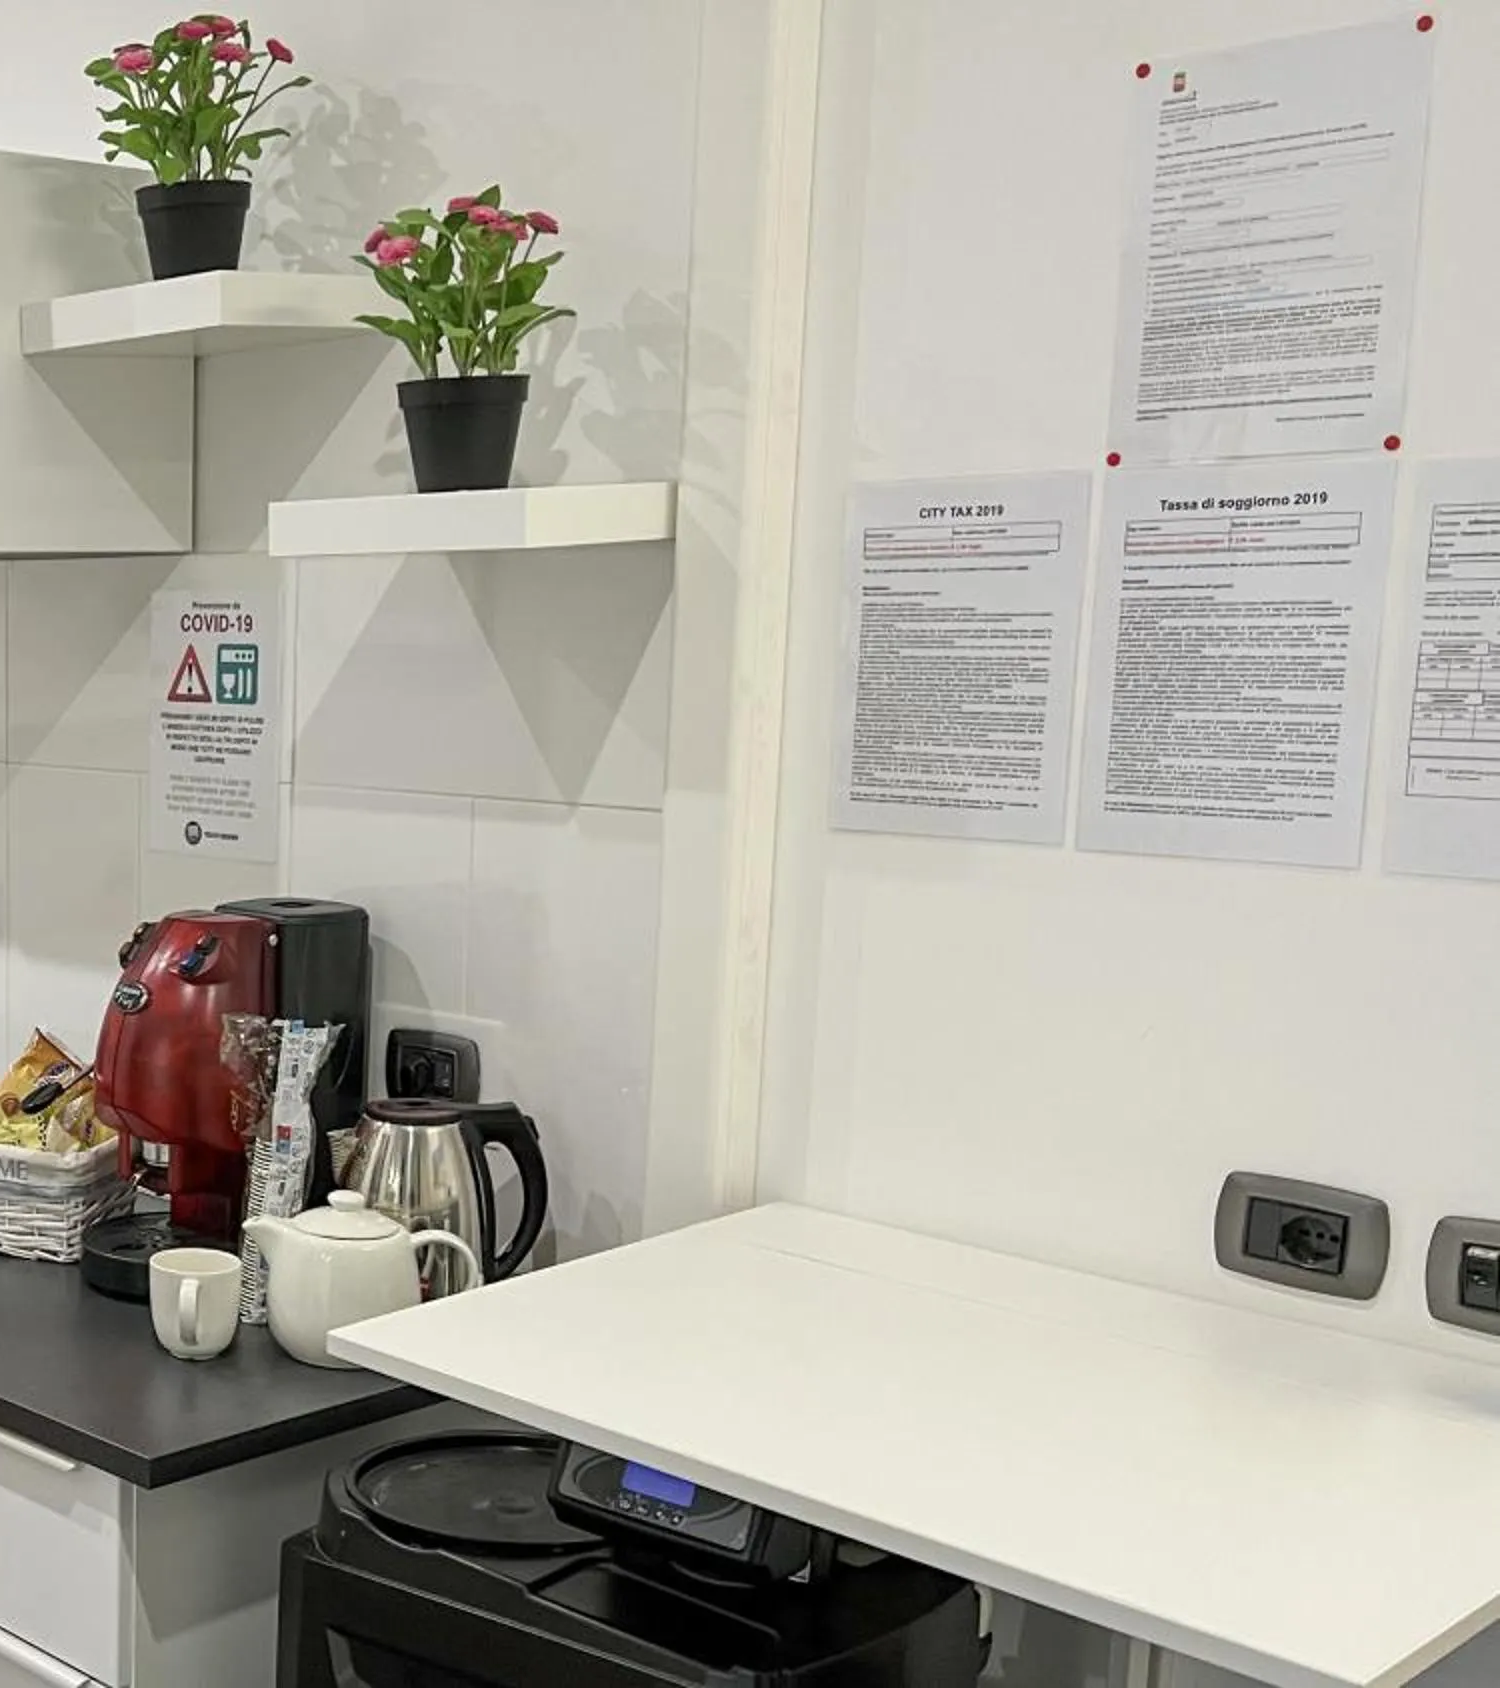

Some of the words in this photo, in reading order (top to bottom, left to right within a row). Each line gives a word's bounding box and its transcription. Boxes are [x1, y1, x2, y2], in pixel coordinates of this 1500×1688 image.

[1160, 498, 1198, 512] Tassa
[1201, 497, 1215, 509] di
[1218, 495, 1291, 511] soggiorno
[1293, 491, 1328, 505] 2019
[919, 506, 947, 519] CITY
[950, 505, 973, 518] TAX
[180, 613, 253, 633] COVID-19
